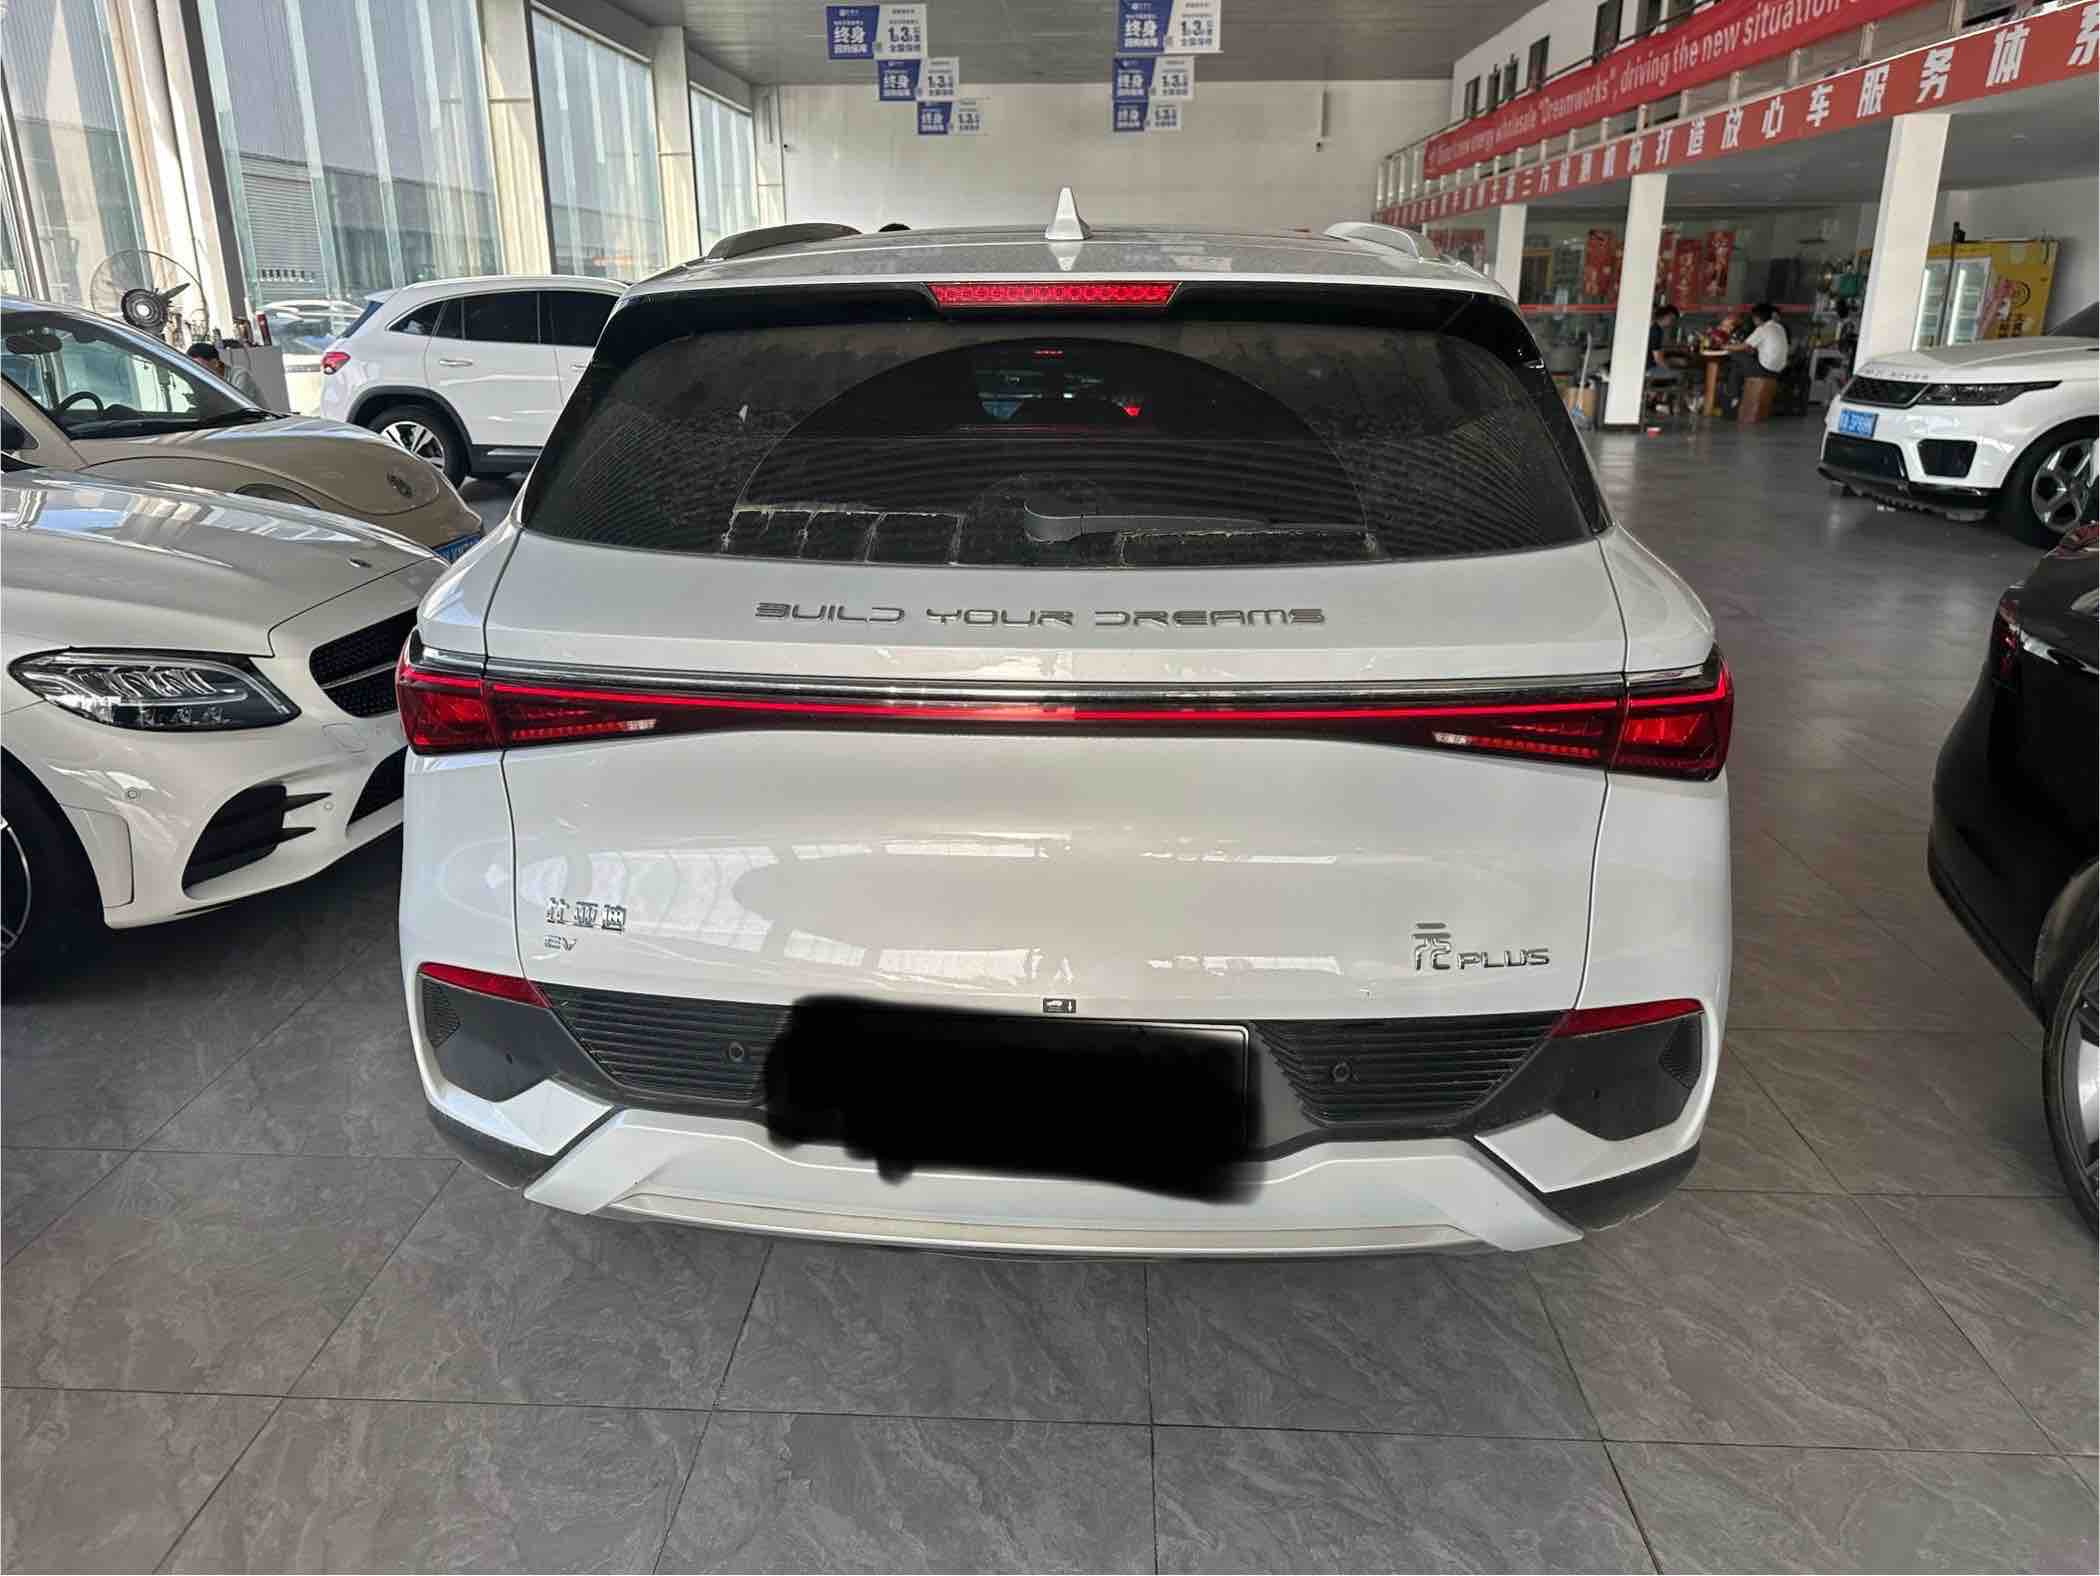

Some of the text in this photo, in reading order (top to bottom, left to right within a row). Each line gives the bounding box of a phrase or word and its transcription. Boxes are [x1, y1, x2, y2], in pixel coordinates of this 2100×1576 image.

[1620, 48, 1672, 94] driving
[1673, 40, 1698, 74] the
[1703, 21, 1743, 63] new
[754, 602, 1325, 626] BUILD YOUR DREAMS
[546, 897, 626, 932] 比亚迪
[544, 934, 577, 951] EV
[1456, 948, 1550, 970] PLUS
